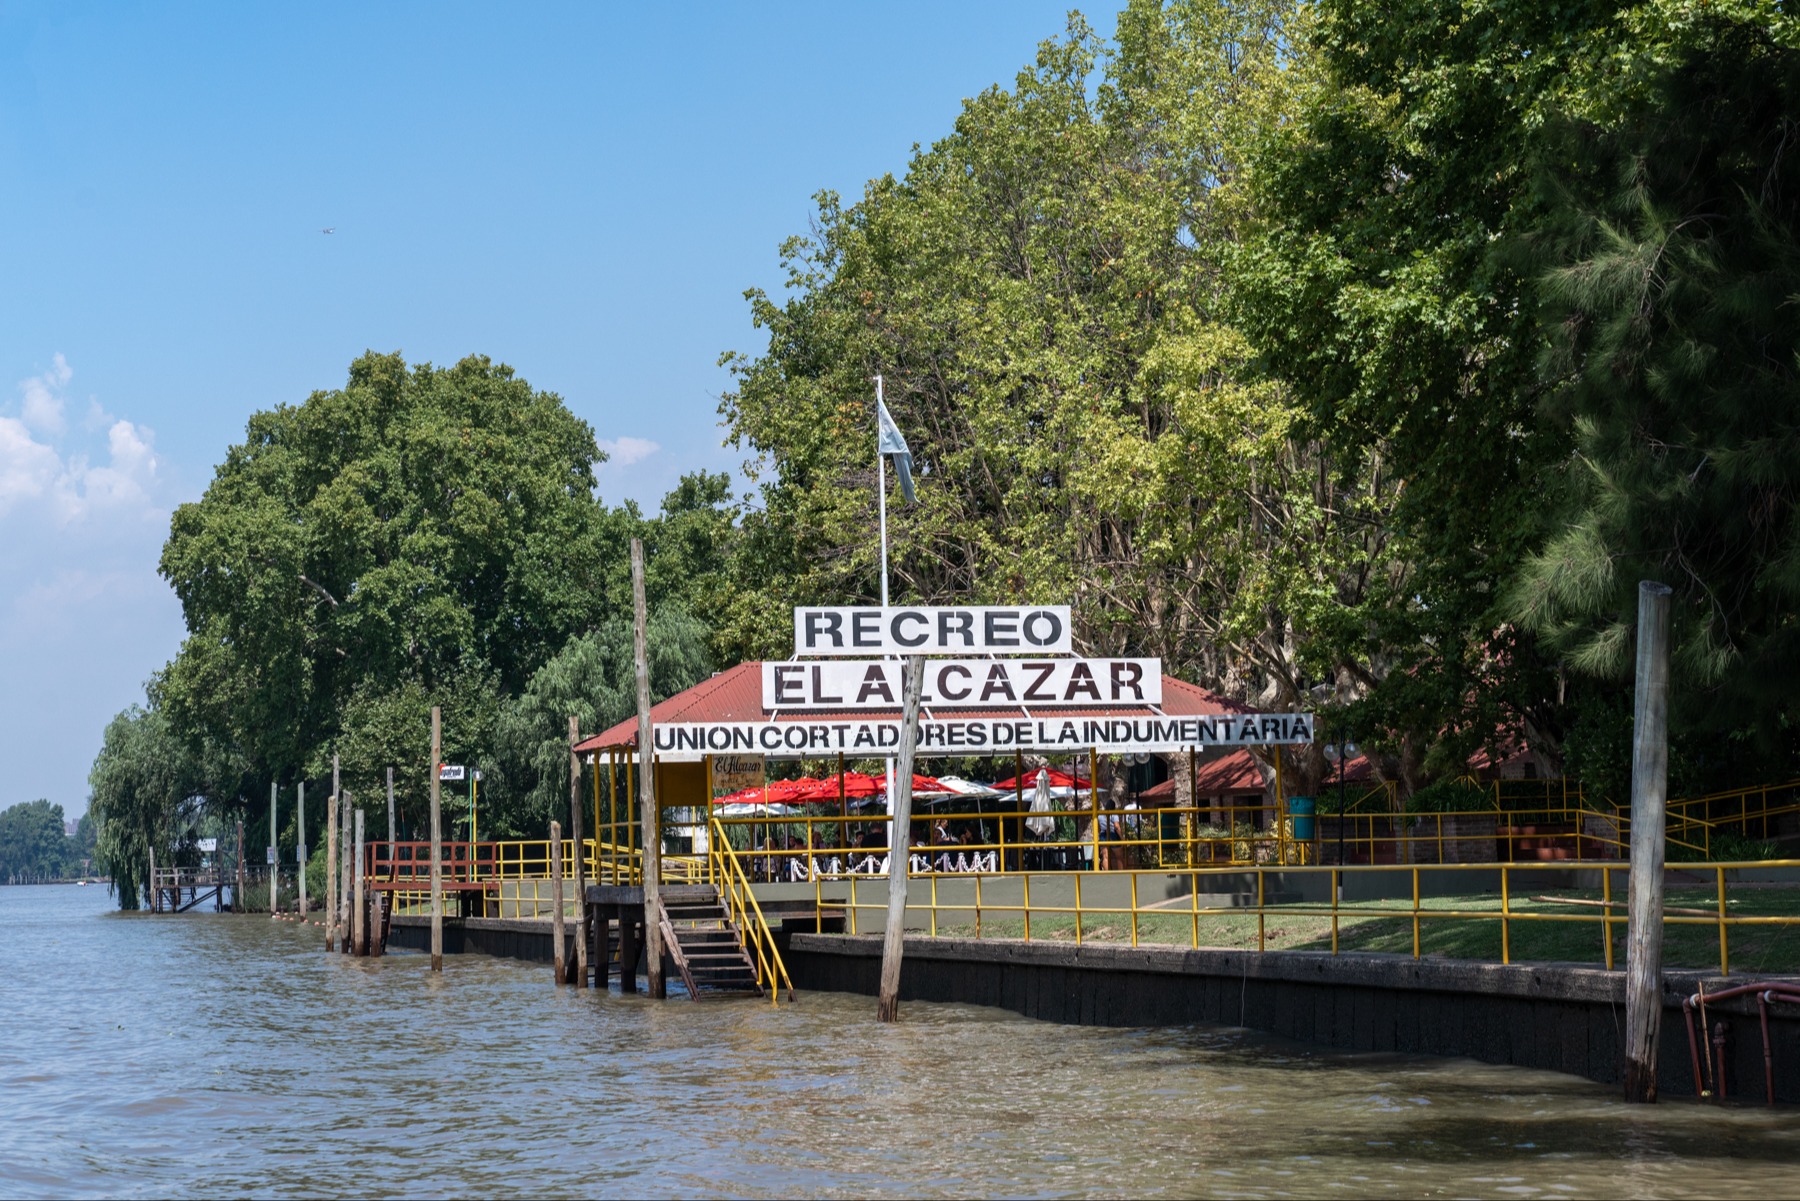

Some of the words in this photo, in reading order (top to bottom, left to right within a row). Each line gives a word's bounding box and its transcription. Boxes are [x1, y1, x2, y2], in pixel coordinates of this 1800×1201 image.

[804, 610, 1063, 648] RECREO
[774, 664, 843, 704] EL
[856, 662, 1145, 703] ALCAZAR
[654, 726, 754, 750] UNION
[992, 721, 1033, 745] DE
[1038, 721, 1080, 744] LA
[1083, 716, 1311, 744] INDUMENTARIA
[715, 756, 727, 772] El
